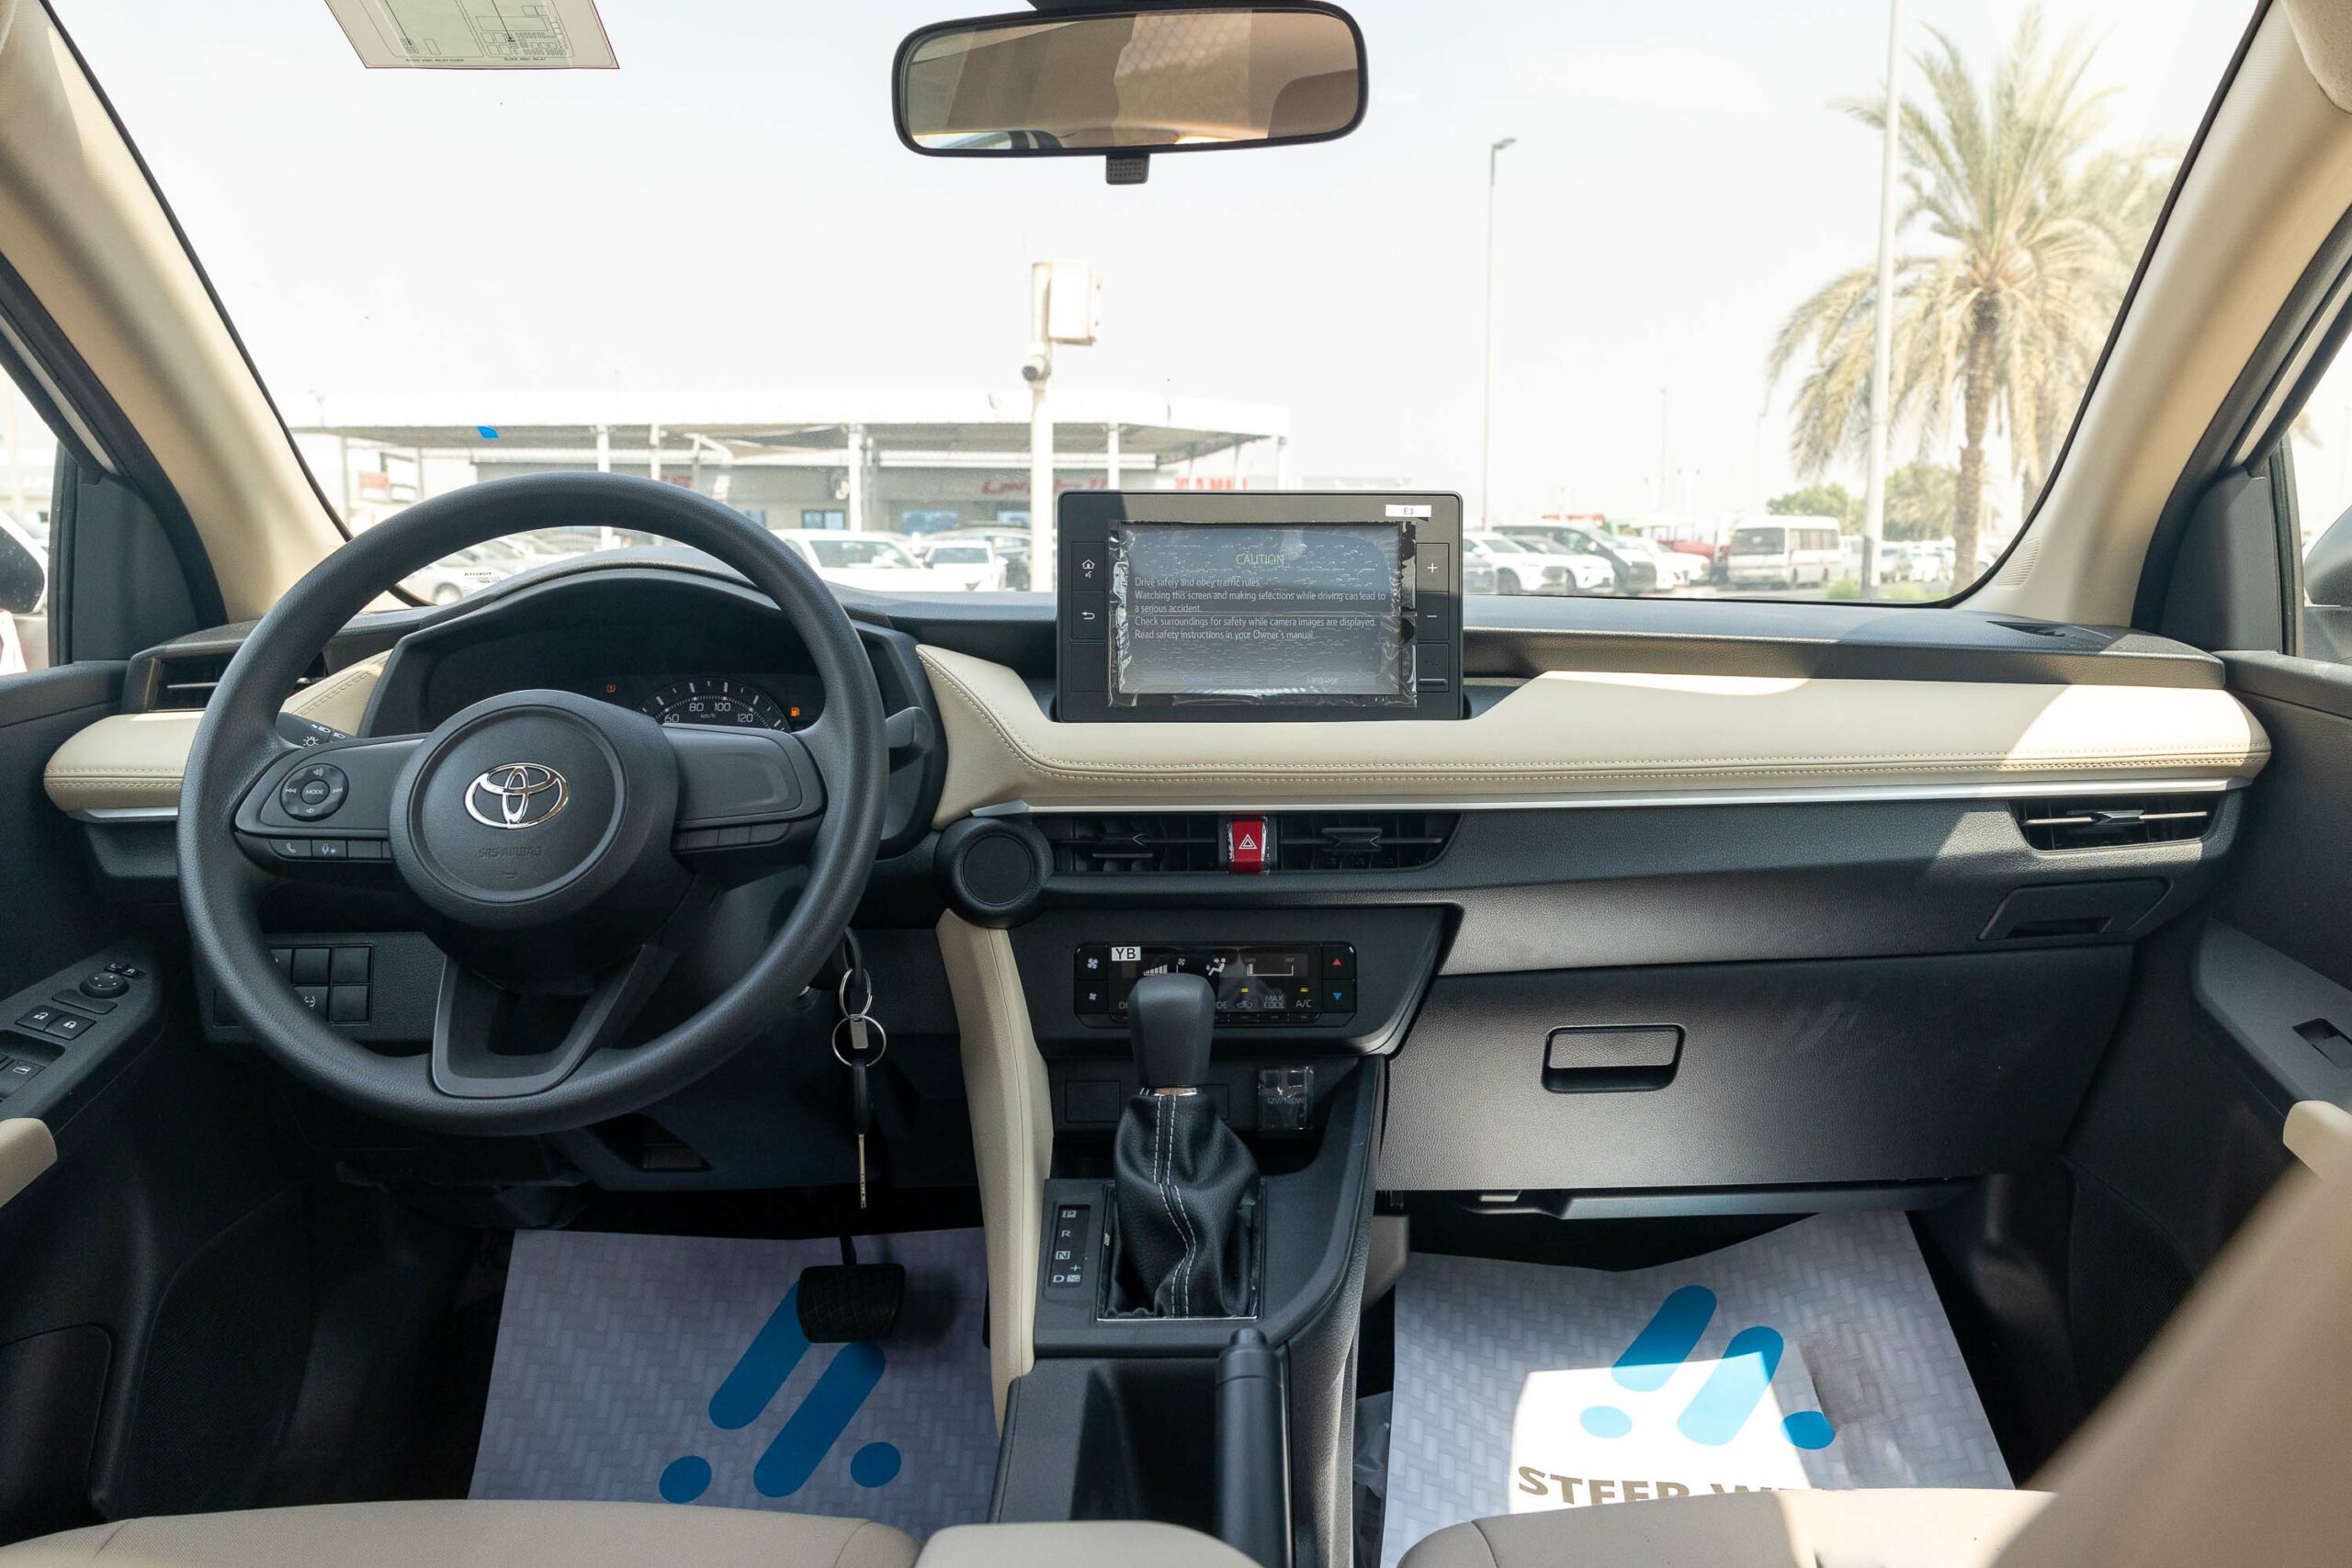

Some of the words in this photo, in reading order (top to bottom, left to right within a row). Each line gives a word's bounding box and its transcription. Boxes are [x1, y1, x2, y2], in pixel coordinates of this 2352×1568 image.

[1236, 554, 1284, 565] CAUTION
[1135, 577, 1155, 587] Drive
[1157, 578, 1178, 588] safely
[1181, 577, 1193, 586] and
[1196, 578, 1216, 588] obey
[1216, 578, 1239, 586] traffic
[1135, 591, 1170, 601] Watching
[1172, 591, 1185, 600] this
[1214, 591, 1227, 600] and
[1229, 591, 1257, 602] making
[1258, 592, 1294, 601] selections
[1296, 592, 1317, 601] while
[1317, 592, 1343, 602] driving
[1360, 592, 1375, 601] lead
[1378, 592, 1385, 601] to
[1141, 604, 1167, 613] serious
[1169, 604, 1202, 613] accident.
[1135, 616, 1158, 626] Check
[1160, 617, 1209, 627] surroundings
[1211, 617, 1221, 626] for
[1224, 617, 1246, 627] safety
[1249, 617, 1268, 626] while
[1298, 617, 1324, 628] images
[1340, 617, 1376, 628] displayed.
[1135, 630, 1154, 639] Read
[1156, 630, 1179, 640] safety
[1181, 630, 1224, 639] instructions
[1226, 630, 1232, 639] in
[1234, 632, 1251, 641] your
[1253, 630, 1284, 639] Owner's
[1286, 630, 1316, 639] manual.
[1306, 675, 1339, 684] Language
[689, 703, 704, 712] 80
[714, 702, 731, 712] 100
[664, 714, 680, 723] 60
[737, 713, 753, 722] 120
[479, 847, 498, 859] SRS
[501, 846, 543, 859] AIRBAG
[1115, 948, 1136, 960] YB
[1295, 999, 1312, 1008] A/C
